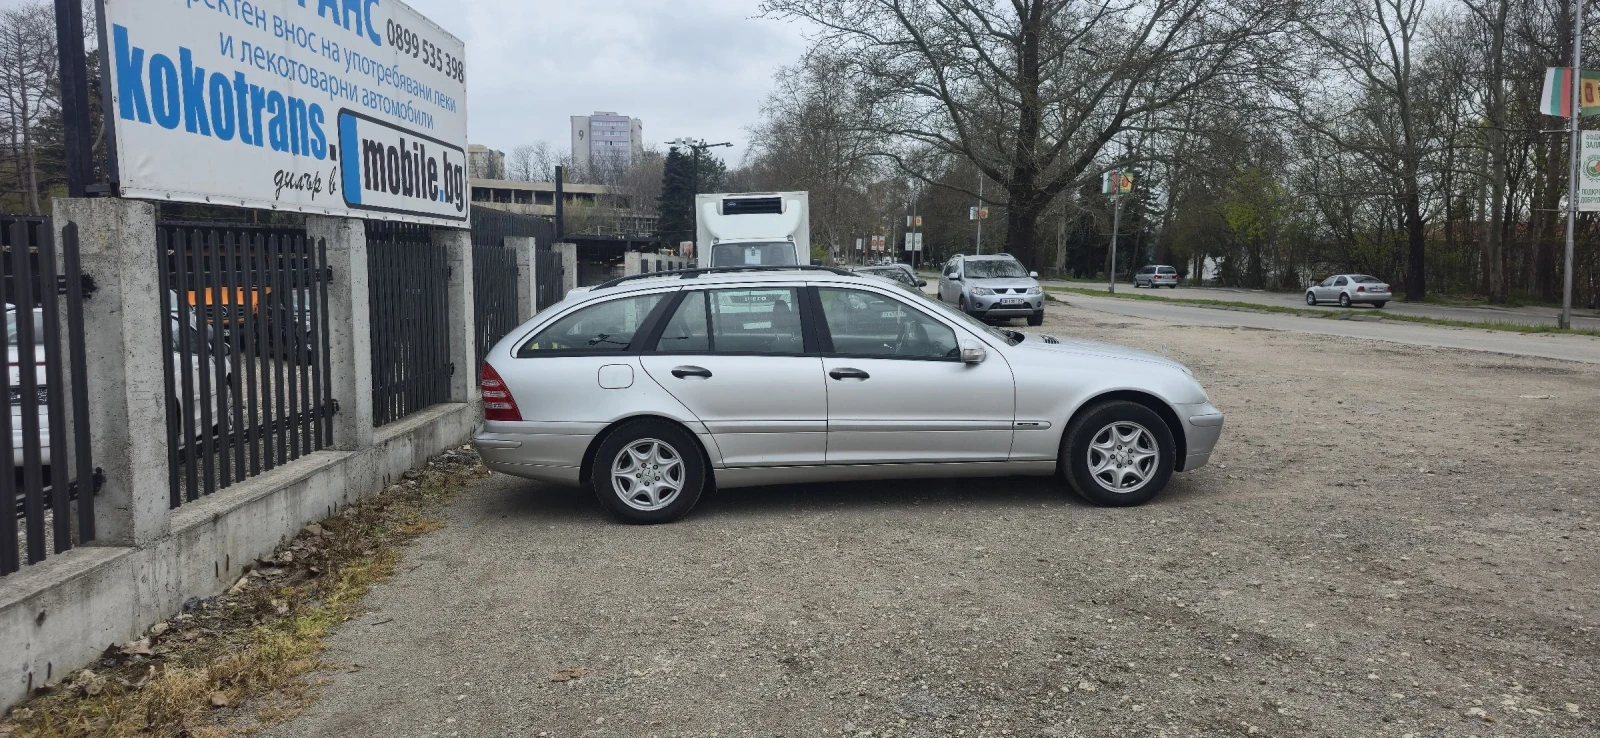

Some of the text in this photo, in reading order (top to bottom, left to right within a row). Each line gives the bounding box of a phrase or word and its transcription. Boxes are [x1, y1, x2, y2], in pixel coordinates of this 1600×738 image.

[219, 31, 434, 130] и лекотоварни автомобили
[273, 14, 317, 53] внос
[321, 37, 341, 61] на
[343, 47, 432, 103] употребявани
[434, 90, 456, 114] леки
[387, 18, 464, 84] 0899 535 398
[578, 129, 584, 141] 9
[273, 169, 323, 201] дилър
[362, 137, 464, 213] mobile.bg
